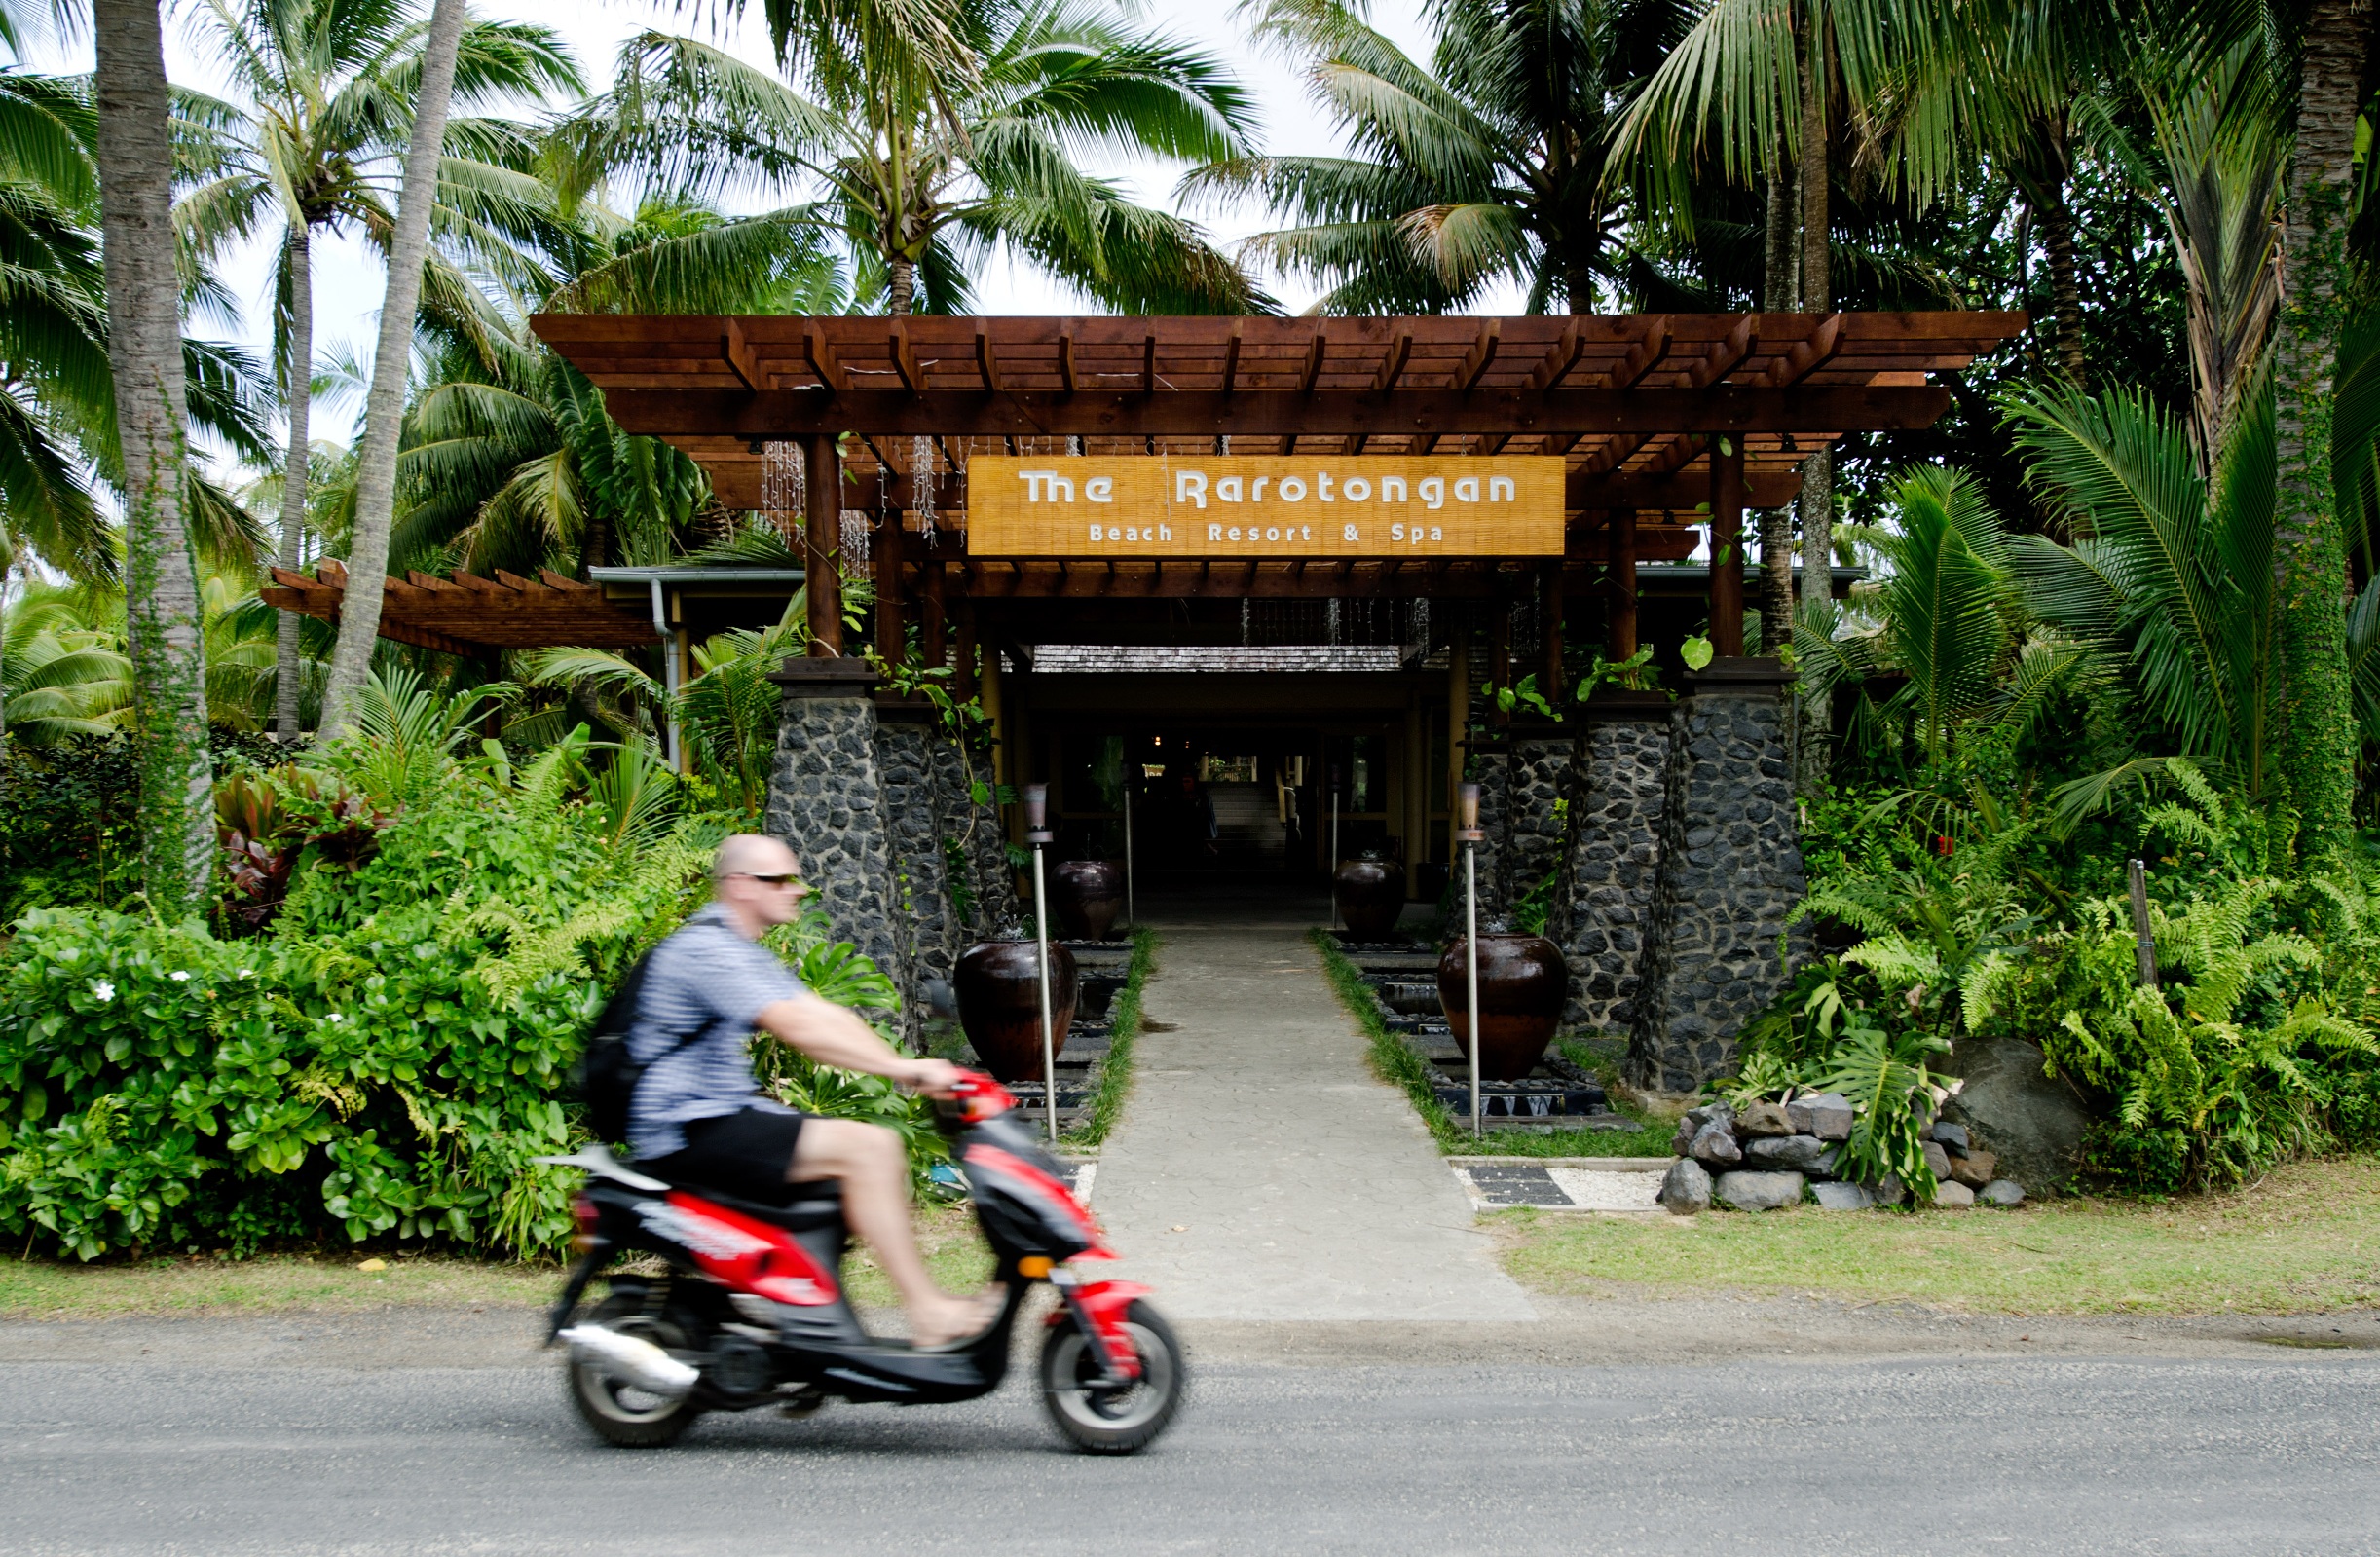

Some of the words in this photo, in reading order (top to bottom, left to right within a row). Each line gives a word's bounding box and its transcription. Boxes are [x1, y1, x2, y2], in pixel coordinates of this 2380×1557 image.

[1018, 470, 1113, 503] The
[1175, 470, 1515, 510] Rarotongan
[1089, 523, 1172, 541] Beach
[1208, 523, 1311, 542] Resort
[1343, 523, 1360, 542] &
[1391, 523, 1443, 545] Spa
